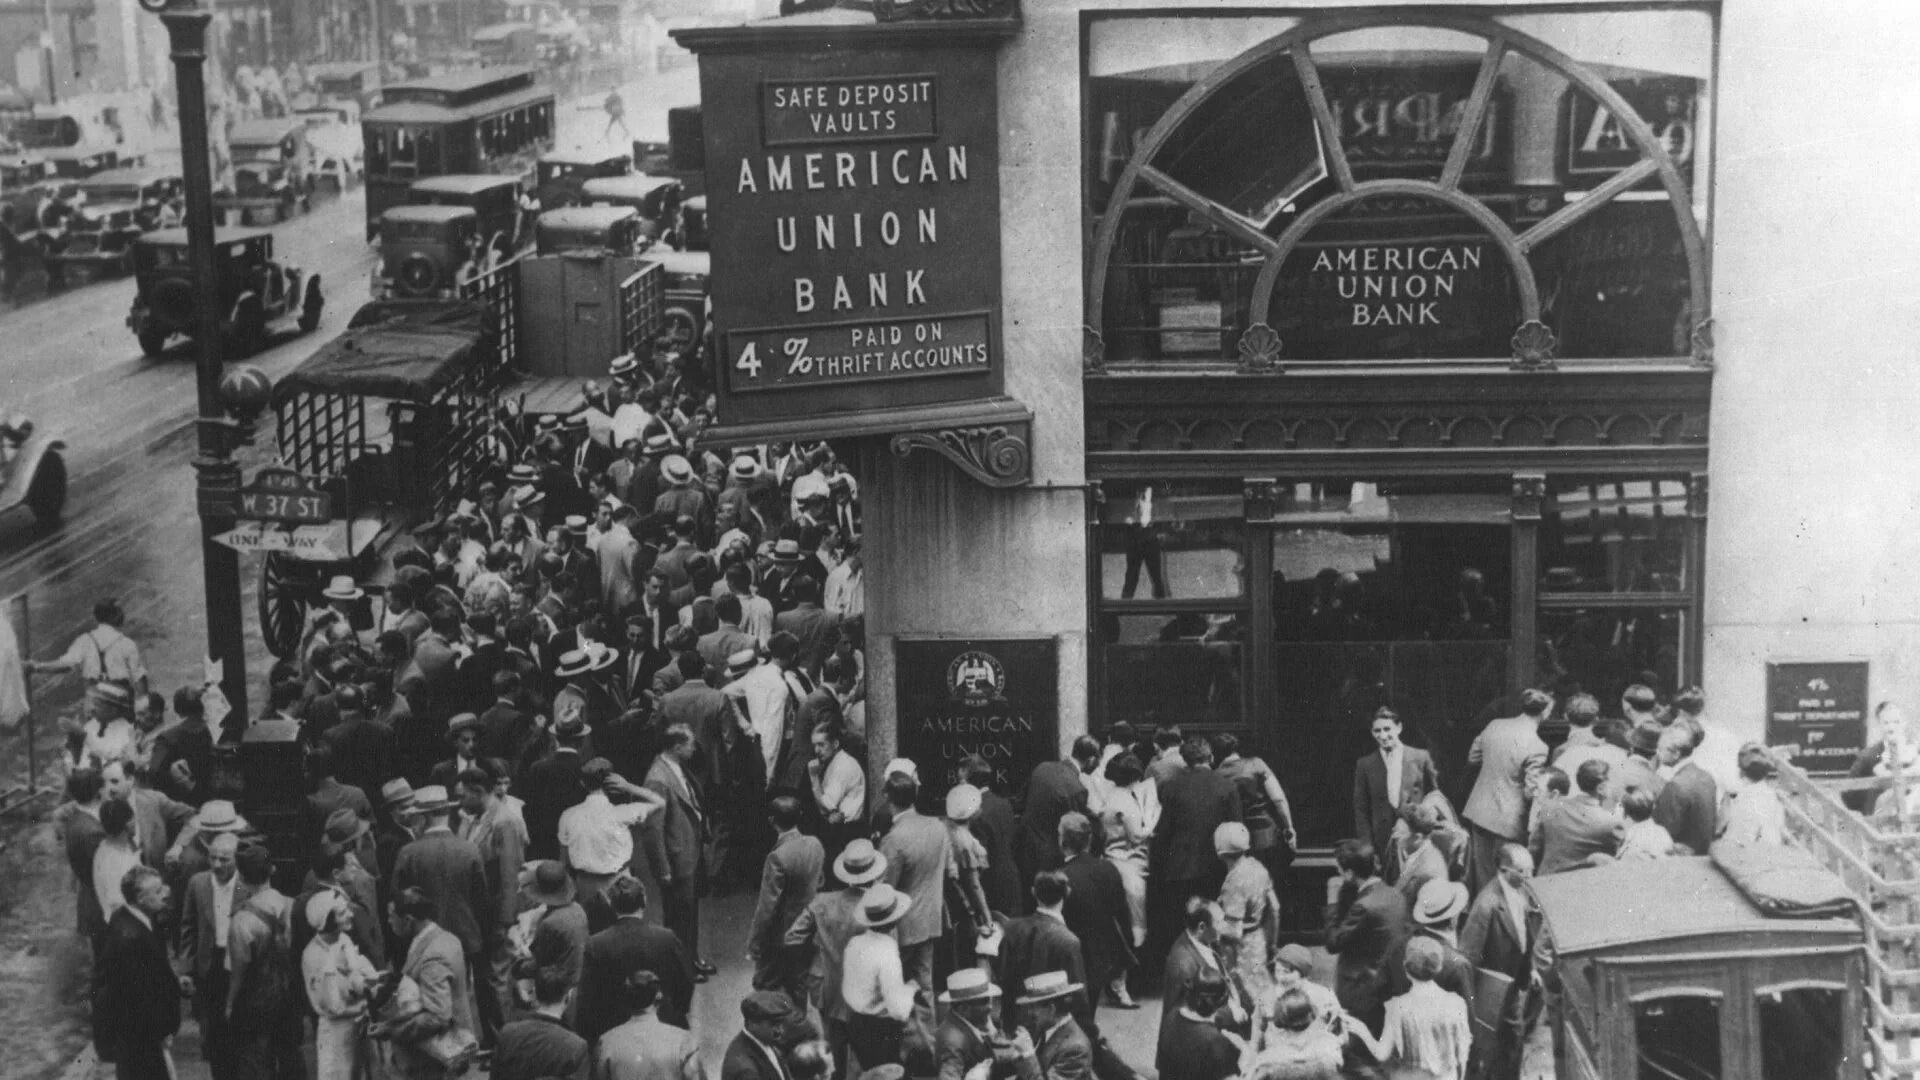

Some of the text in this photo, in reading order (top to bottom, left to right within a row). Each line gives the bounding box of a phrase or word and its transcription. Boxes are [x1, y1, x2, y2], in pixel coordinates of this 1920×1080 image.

[775, 81, 931, 108] SAFE DEPOSIT
[810, 110, 897, 134] VAULTS
[738, 145, 968, 194] AMERICAN
[776, 207, 937, 252] UNION
[1311, 246, 1482, 272] AMERICAN
[794, 269, 927, 313] BANK
[1337, 275, 1454, 299] UNION
[1352, 302, 1441, 326] BANK
[851, 322, 943, 347] PAID ON
[816, 343, 988, 376] THRIFT ACCOUNTS
[241, 494, 257, 510] W
[266, 495, 290, 517] 37
[921, 716, 1033, 733] AMERICAN
[947, 768, 1008, 785] BK
